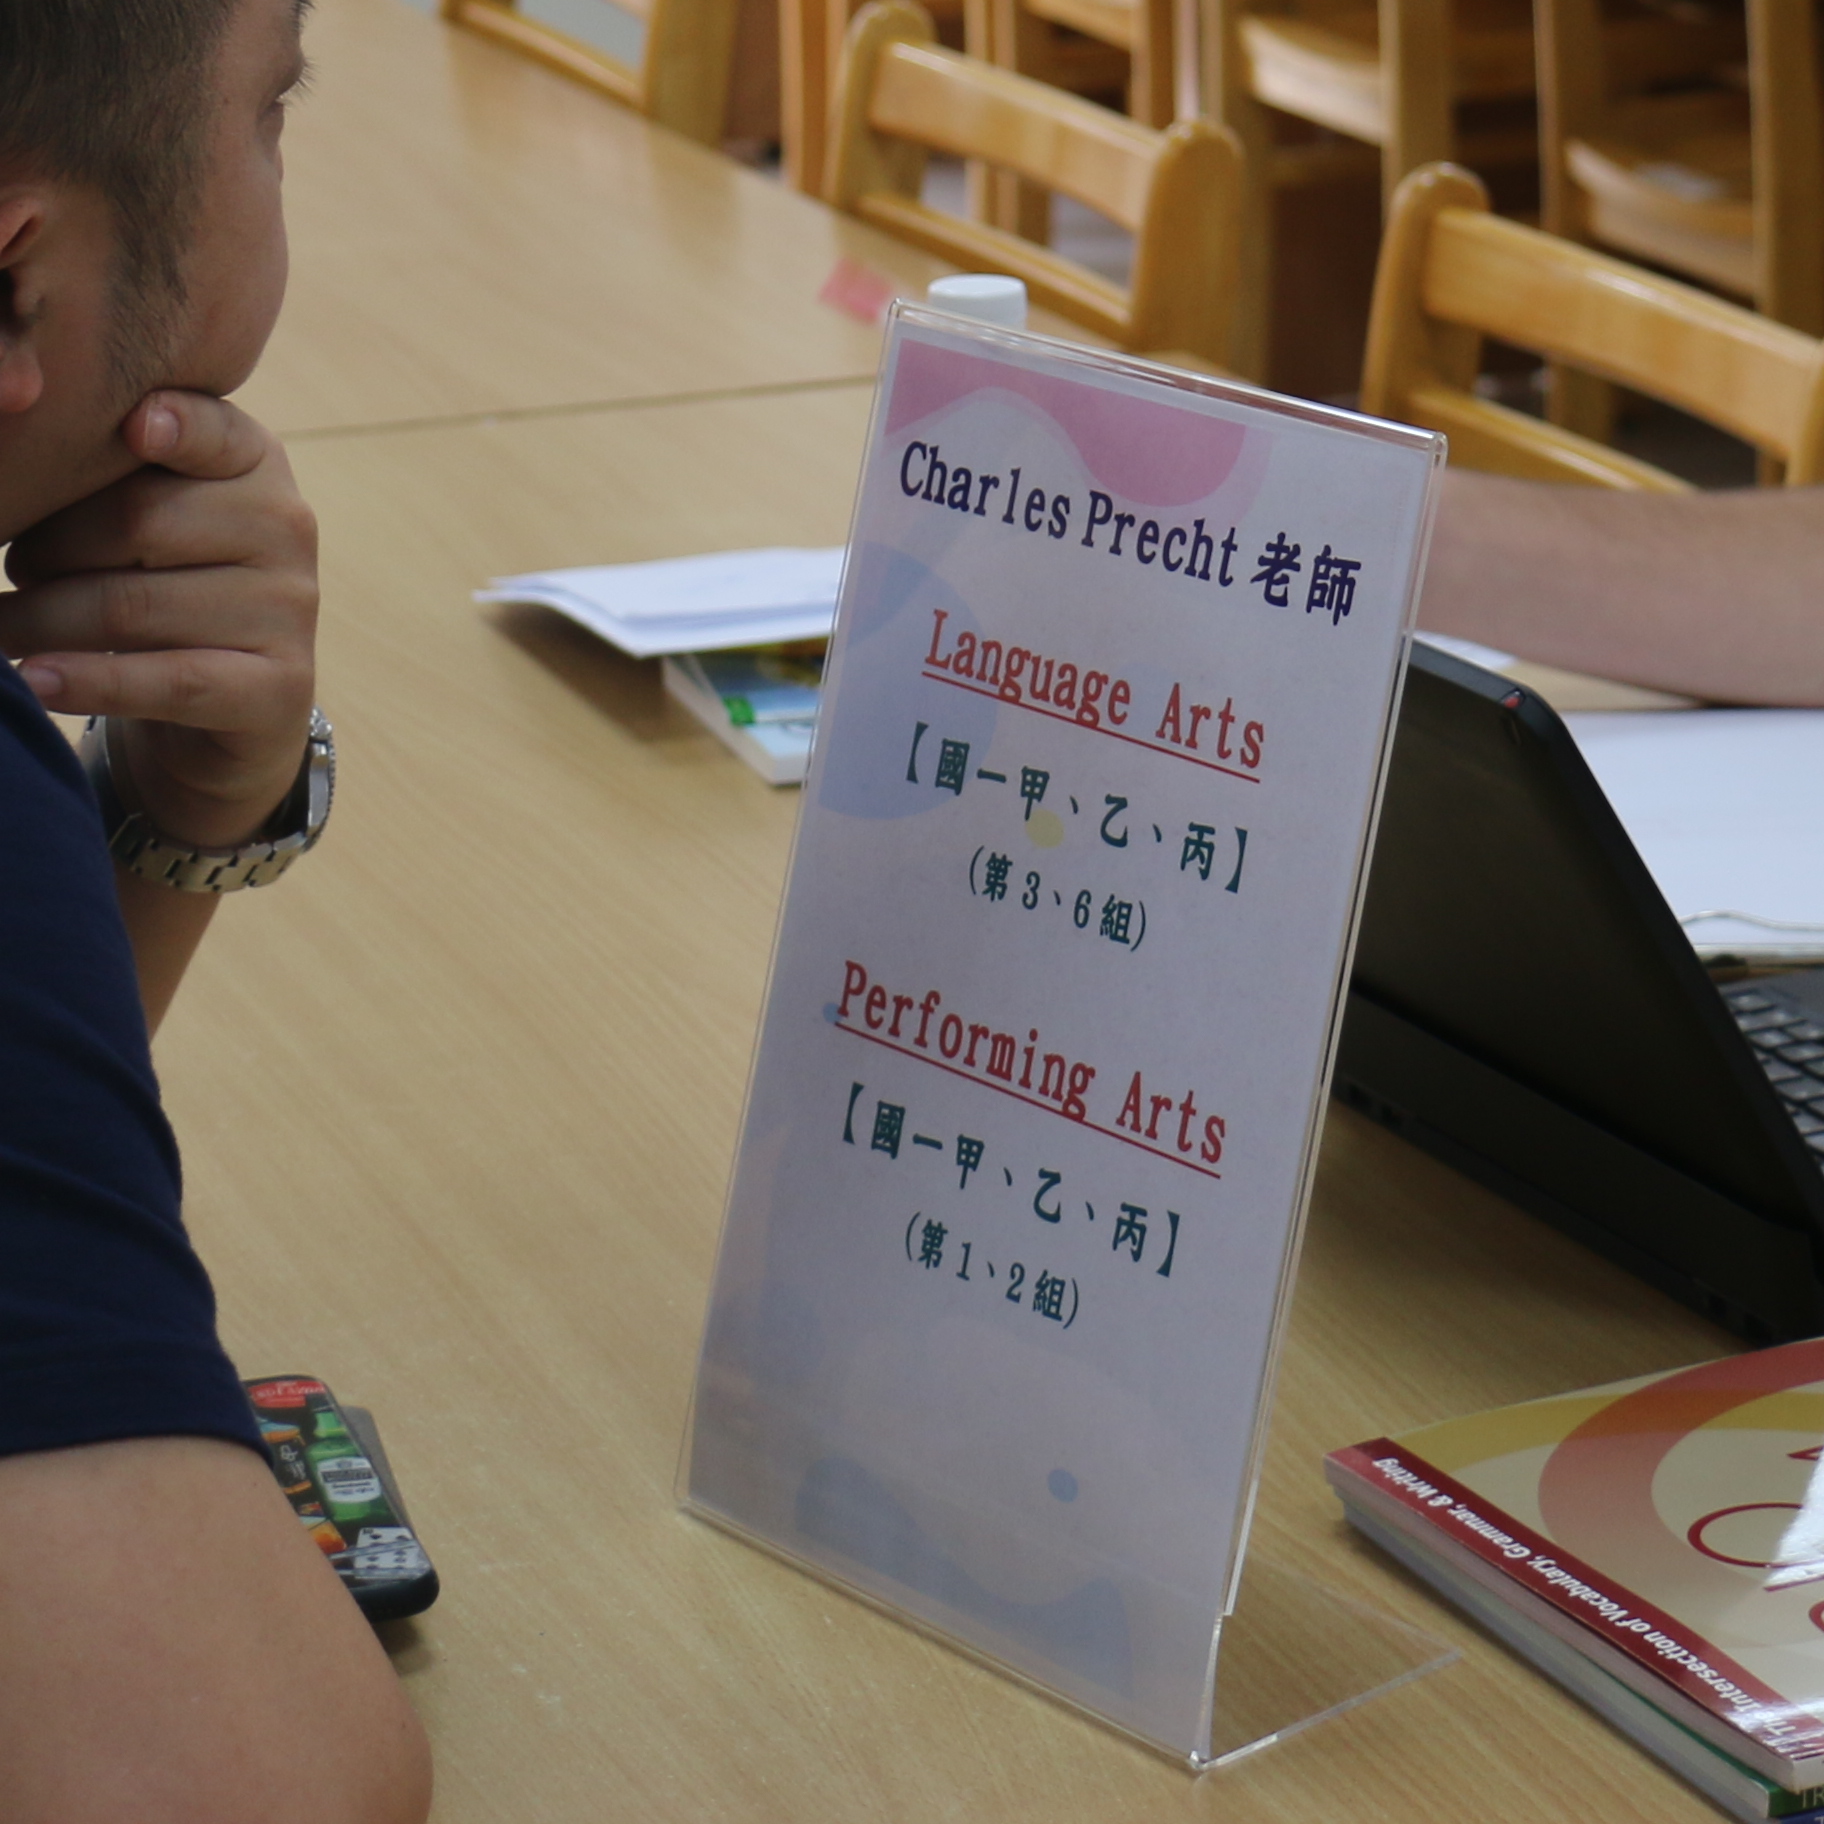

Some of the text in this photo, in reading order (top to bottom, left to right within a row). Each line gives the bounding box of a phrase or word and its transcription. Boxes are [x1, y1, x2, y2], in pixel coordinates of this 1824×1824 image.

[899, 439, 1361, 626] Charles Precht 老師
[923, 608, 1266, 770] Language Arts
[837, 960, 1227, 1164] Performing Arts
[1372, 1457, 1439, 1499] Writing
[1428, 1494, 1454, 1507] &
[1447, 1504, 1531, 1559] Grammar,
[1527, 1555, 1628, 1622] Vocabulary,
[1615, 1617, 1652, 1628] of
[1643, 1630, 1762, 1713] Intersection
